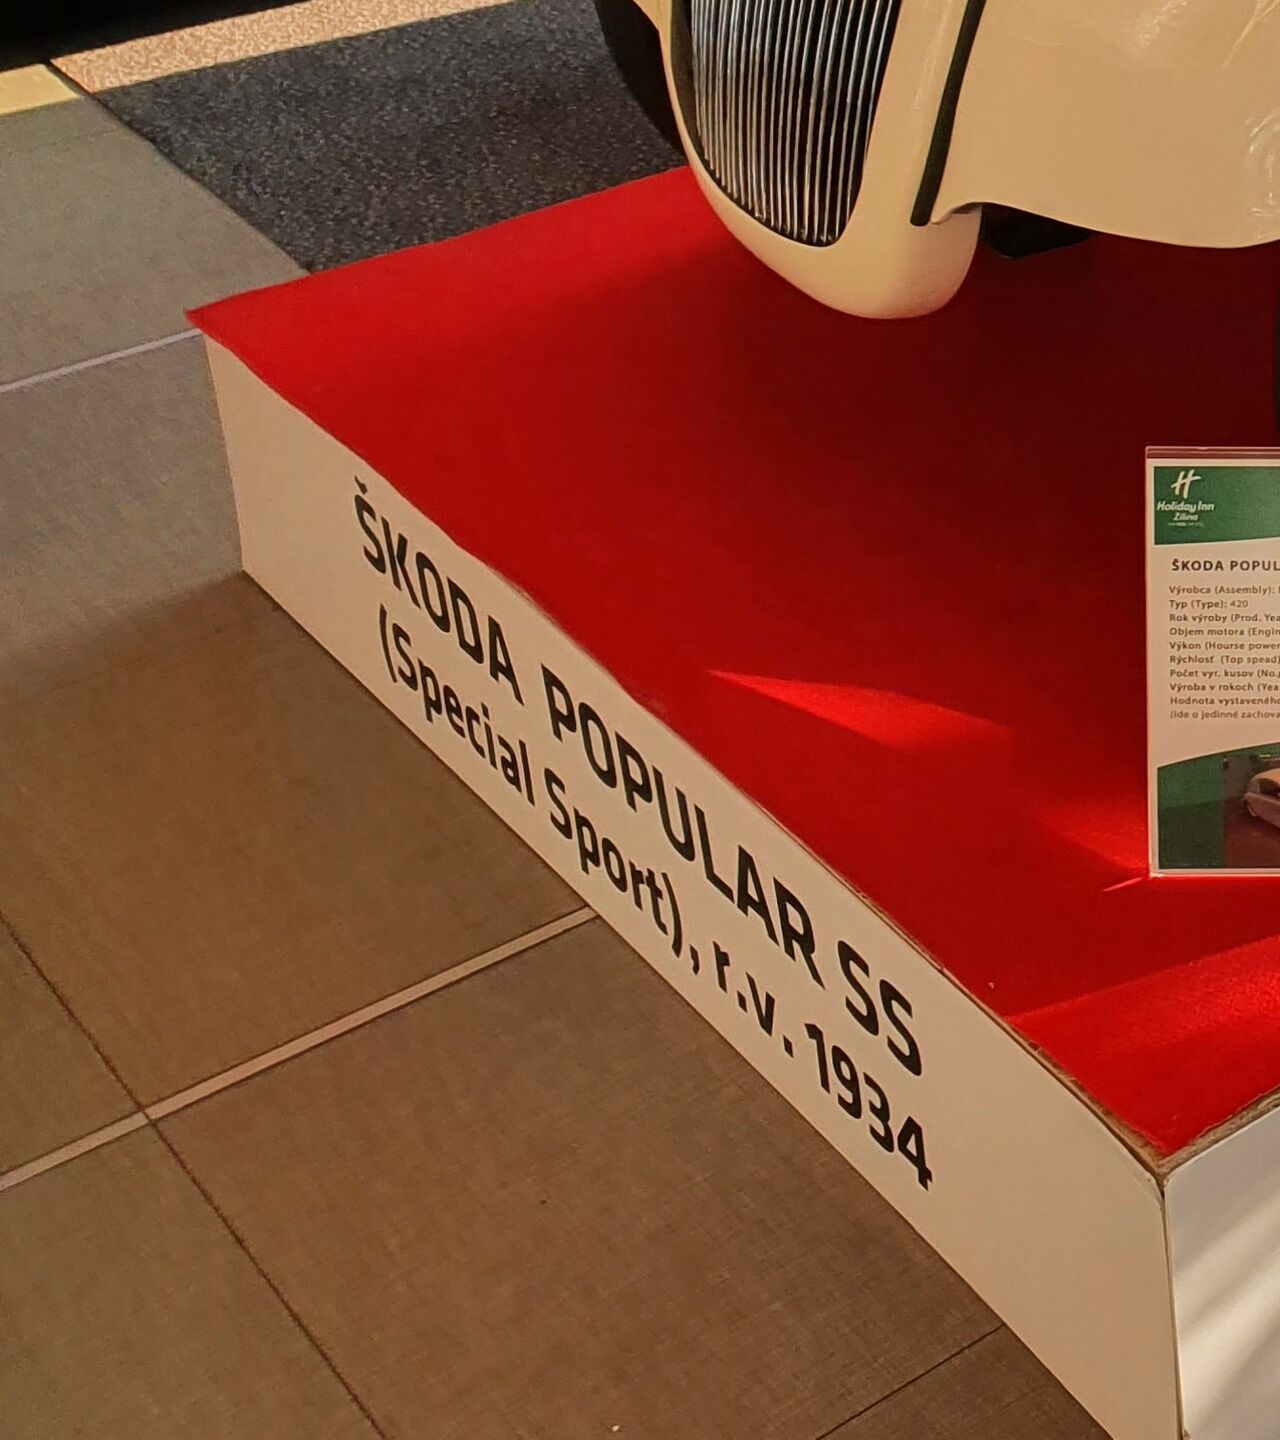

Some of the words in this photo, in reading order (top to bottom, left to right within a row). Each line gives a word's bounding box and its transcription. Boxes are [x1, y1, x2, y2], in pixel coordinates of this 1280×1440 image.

[1157, 501, 1196, 513] Holiday
[1197, 501, 1215, 511] Inn
[1171, 558, 1224, 571] ŠKODA
[1169, 585, 1211, 595] Výrobca
[1214, 585, 1275, 596] (Assembly):
[1169, 599, 1188, 609] Typ
[1191, 599, 1228, 609] (Type):
[1230, 599, 1249, 608] 420
[1169, 613, 1189, 622] Rok
[1191, 613, 1228, 623] výroby
[1230, 613, 1262, 623] (Prod.
[1169, 627, 1204, 637] Objem
[1207, 627, 1245, 636] motora
[1169, 641, 1202, 651] Výkon
[1204, 641, 1246, 651] (Hourse
[1220, 655, 1244, 665] (Top
[1169, 668, 1199, 678] Počet
[1223, 669, 1254, 678] kusov
[1169, 682, 1206, 693] Výroba
[1208, 684, 1216, 692] v
[1218, 682, 1254, 692] rokoch
[1169, 696, 1216, 705] Hodnota
[354, 476, 524, 705] ŠKODA
[541, 663, 826, 990] POPULAR
[837, 939, 923, 1079] SS
[378, 605, 536, 806] (Special
[544, 768, 700, 975] Sport),
[713, 941, 795, 1059] r.v.
[805, 1023, 934, 1192] 1934
